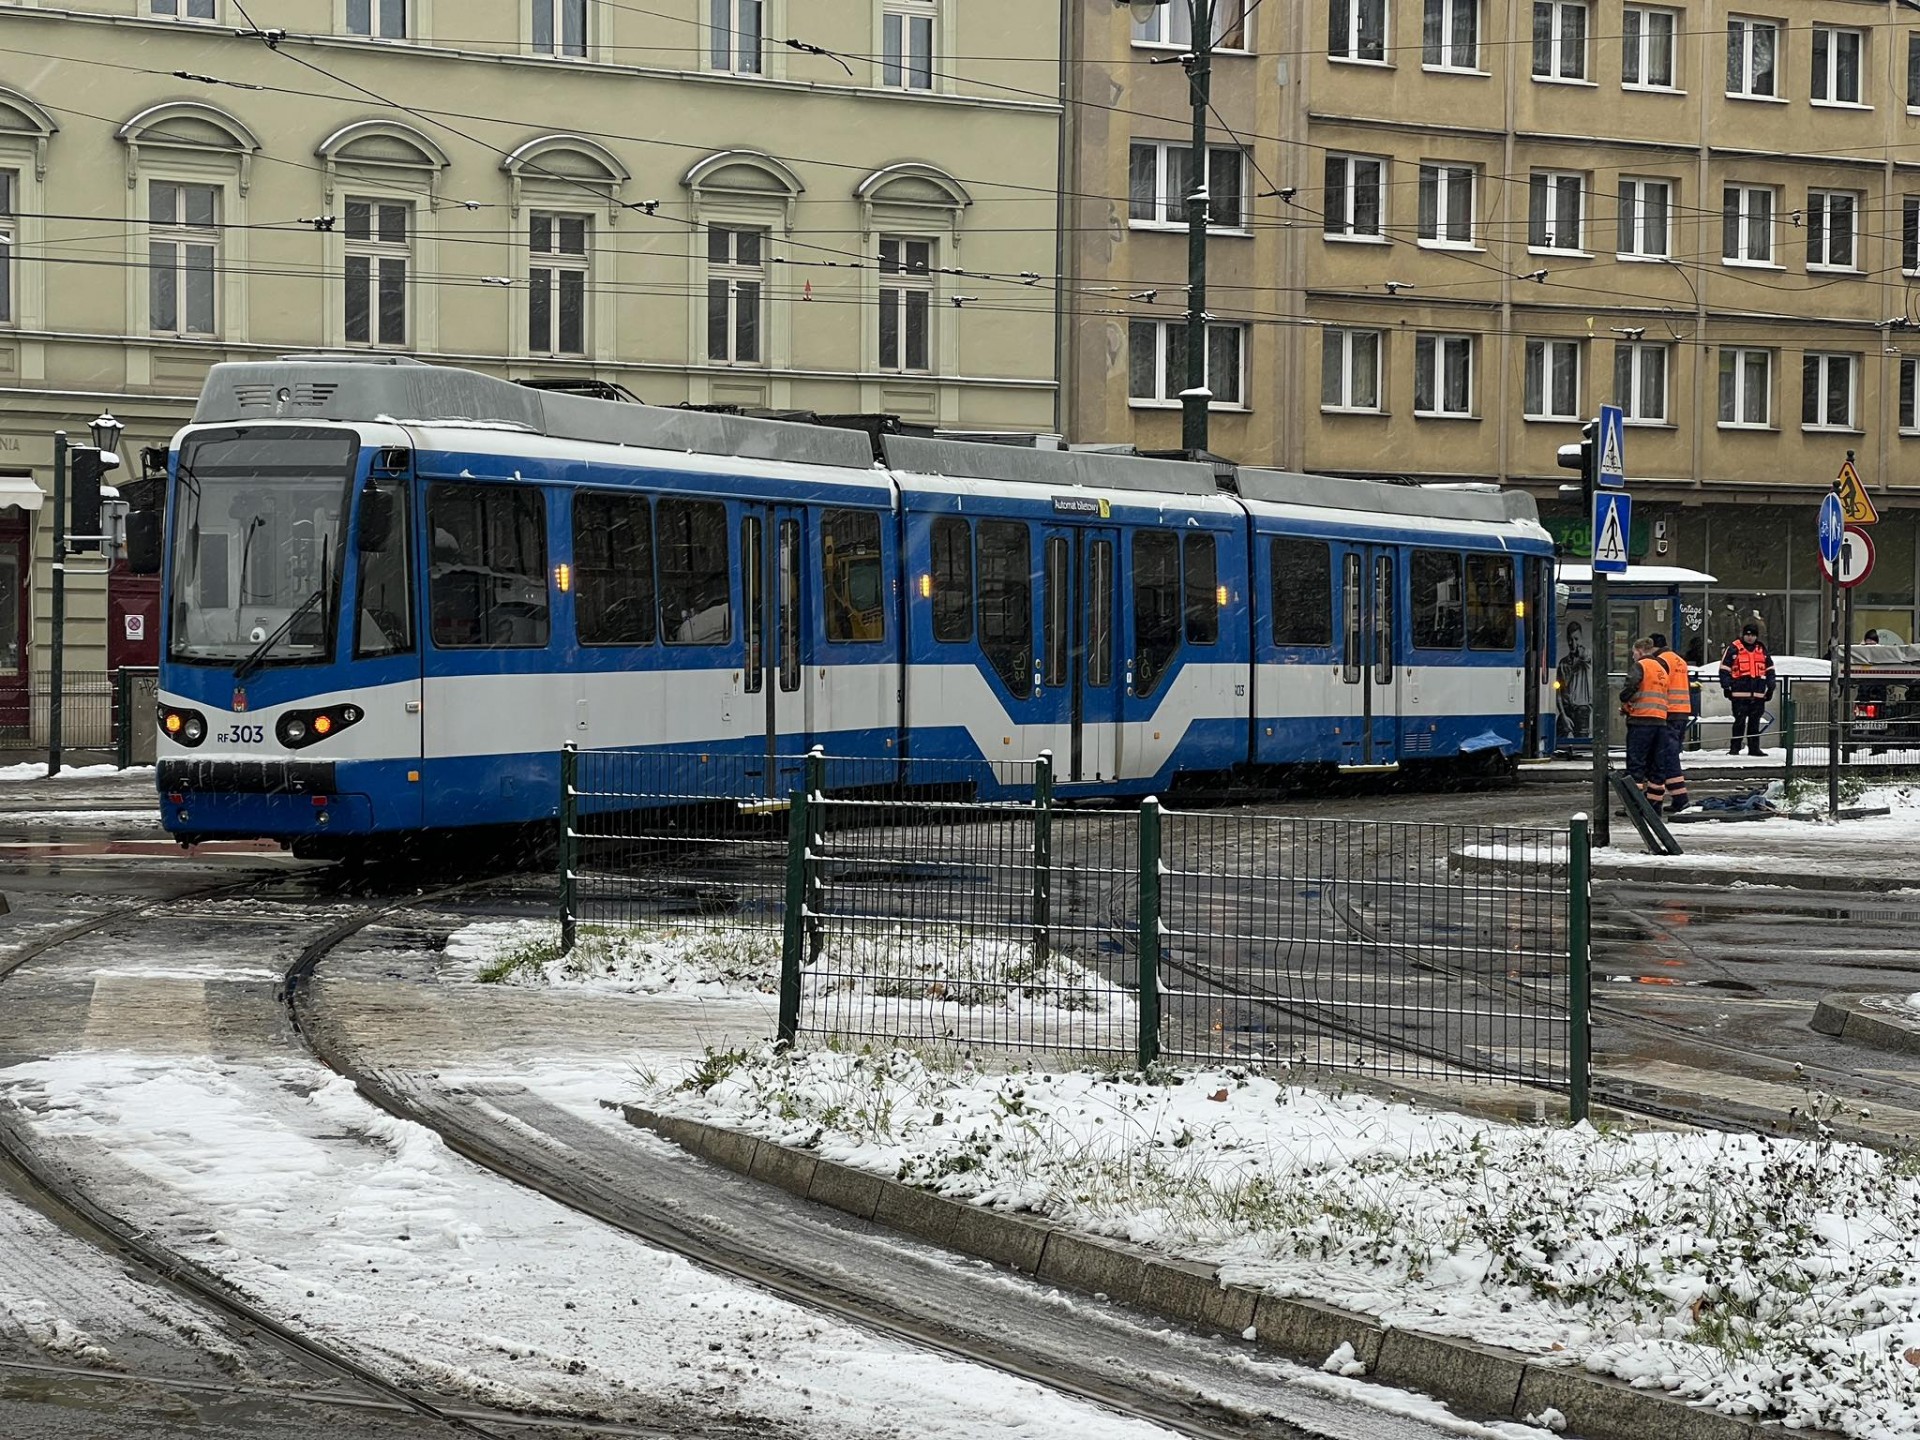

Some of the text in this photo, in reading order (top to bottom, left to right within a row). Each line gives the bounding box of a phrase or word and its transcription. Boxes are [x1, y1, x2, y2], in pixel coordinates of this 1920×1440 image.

[1054, 499, 1099, 513] Automat biletowy
[1685, 614, 1702, 628] Shop
